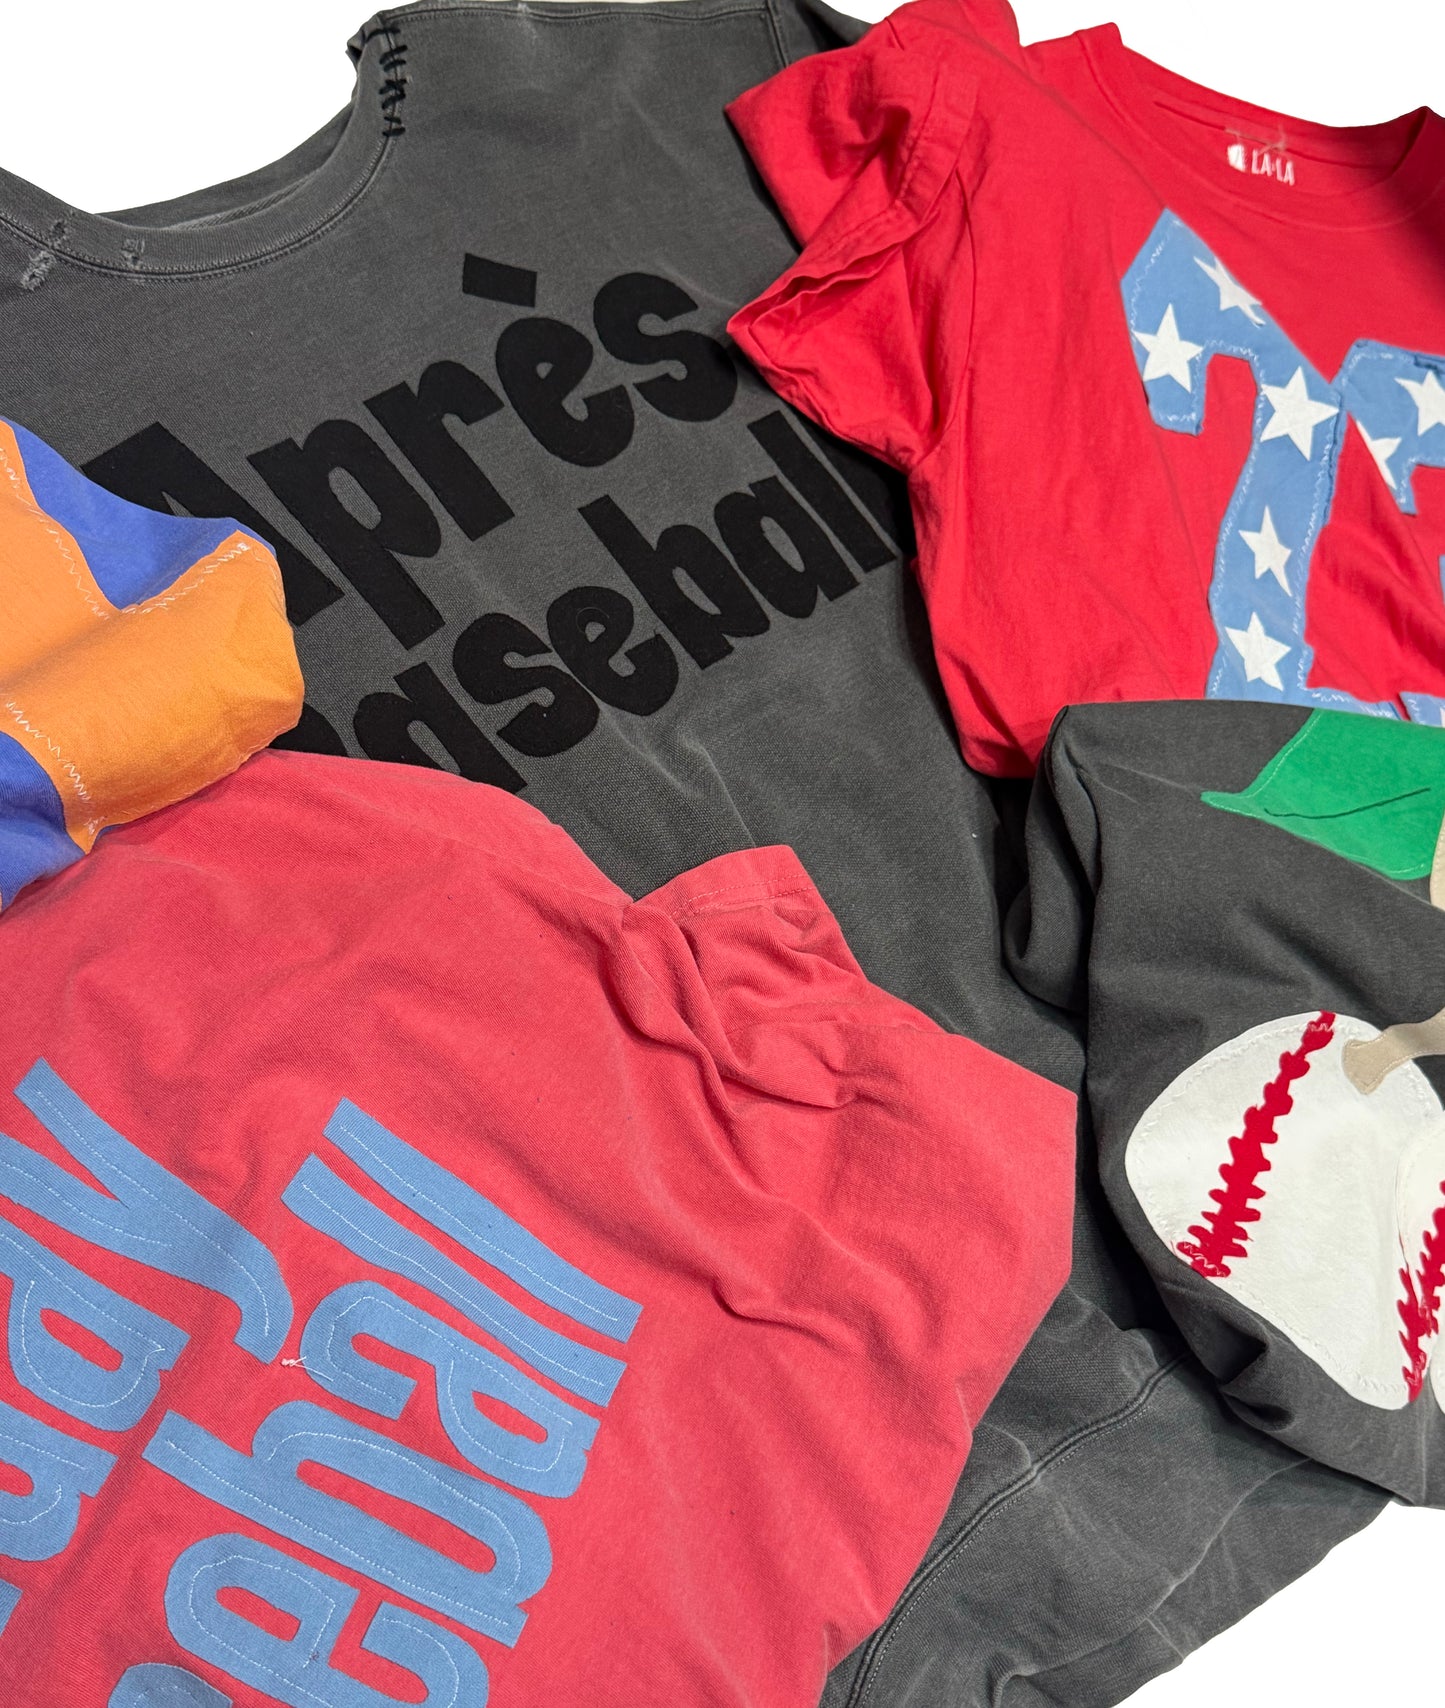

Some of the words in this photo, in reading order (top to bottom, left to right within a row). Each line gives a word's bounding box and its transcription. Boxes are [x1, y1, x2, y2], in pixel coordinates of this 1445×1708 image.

[80, 253, 738, 650] Après
[270, 409, 901, 795] asebal
[107, 1096, 644, 1708] eball
